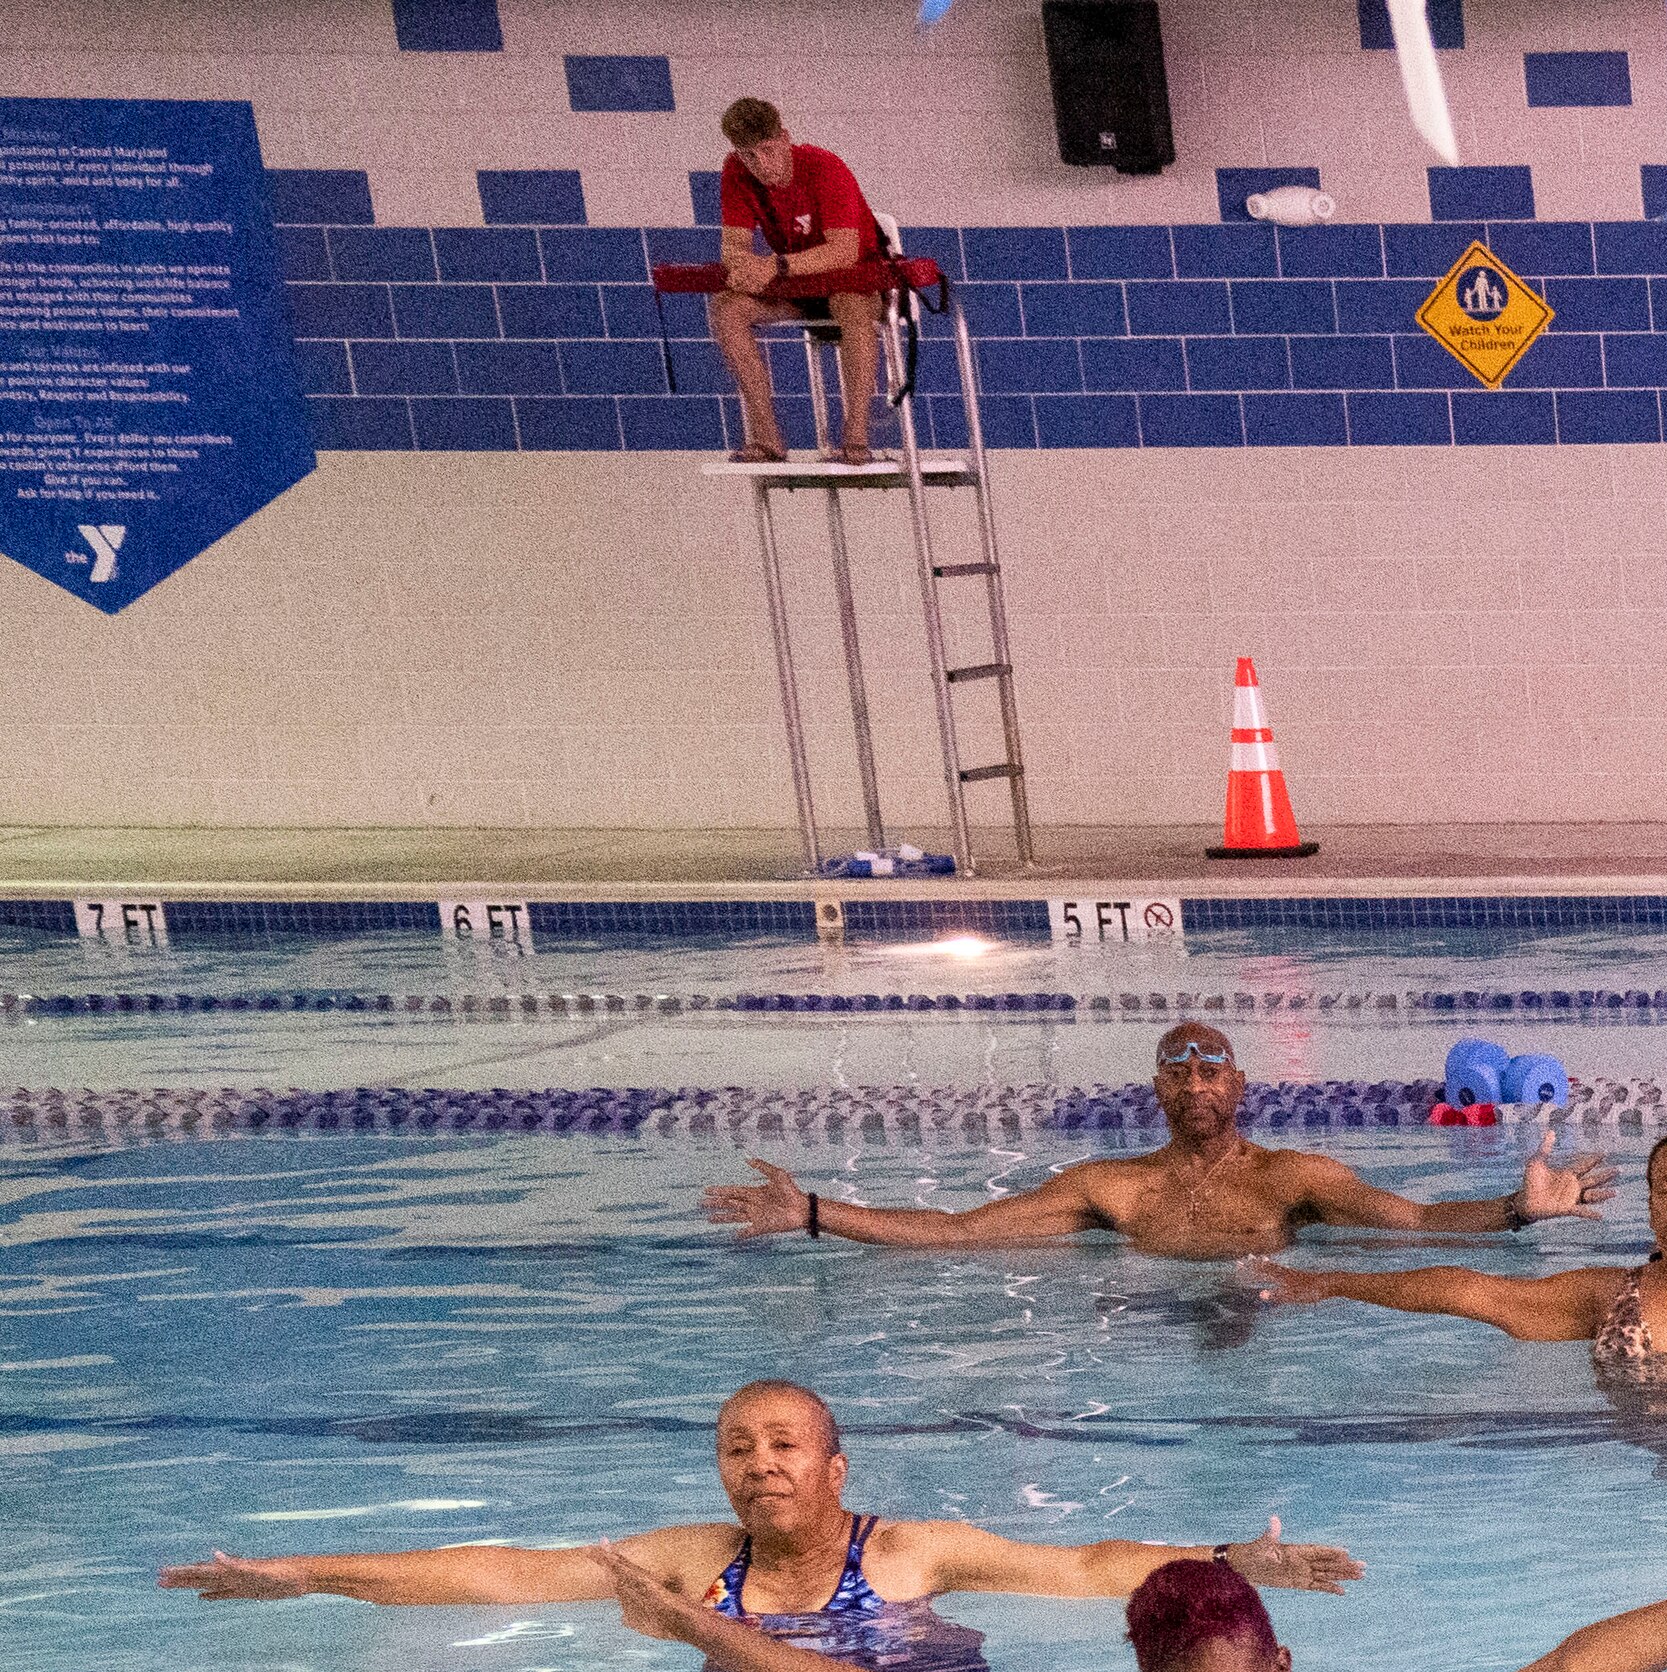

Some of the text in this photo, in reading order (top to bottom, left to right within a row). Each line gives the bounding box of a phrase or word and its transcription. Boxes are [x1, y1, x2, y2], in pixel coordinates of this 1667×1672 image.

[1450, 323, 1524, 337] Watch Your
[1460, 339, 1515, 351] Children
[17, 488, 38, 499] Ask
[39, 488, 57, 499] for
[65, 524, 126, 583] the Y
[87, 904, 157, 947] 7 FT
[453, 904, 523, 945] 6 FT
[1064, 902, 1131, 942] 5 FT
